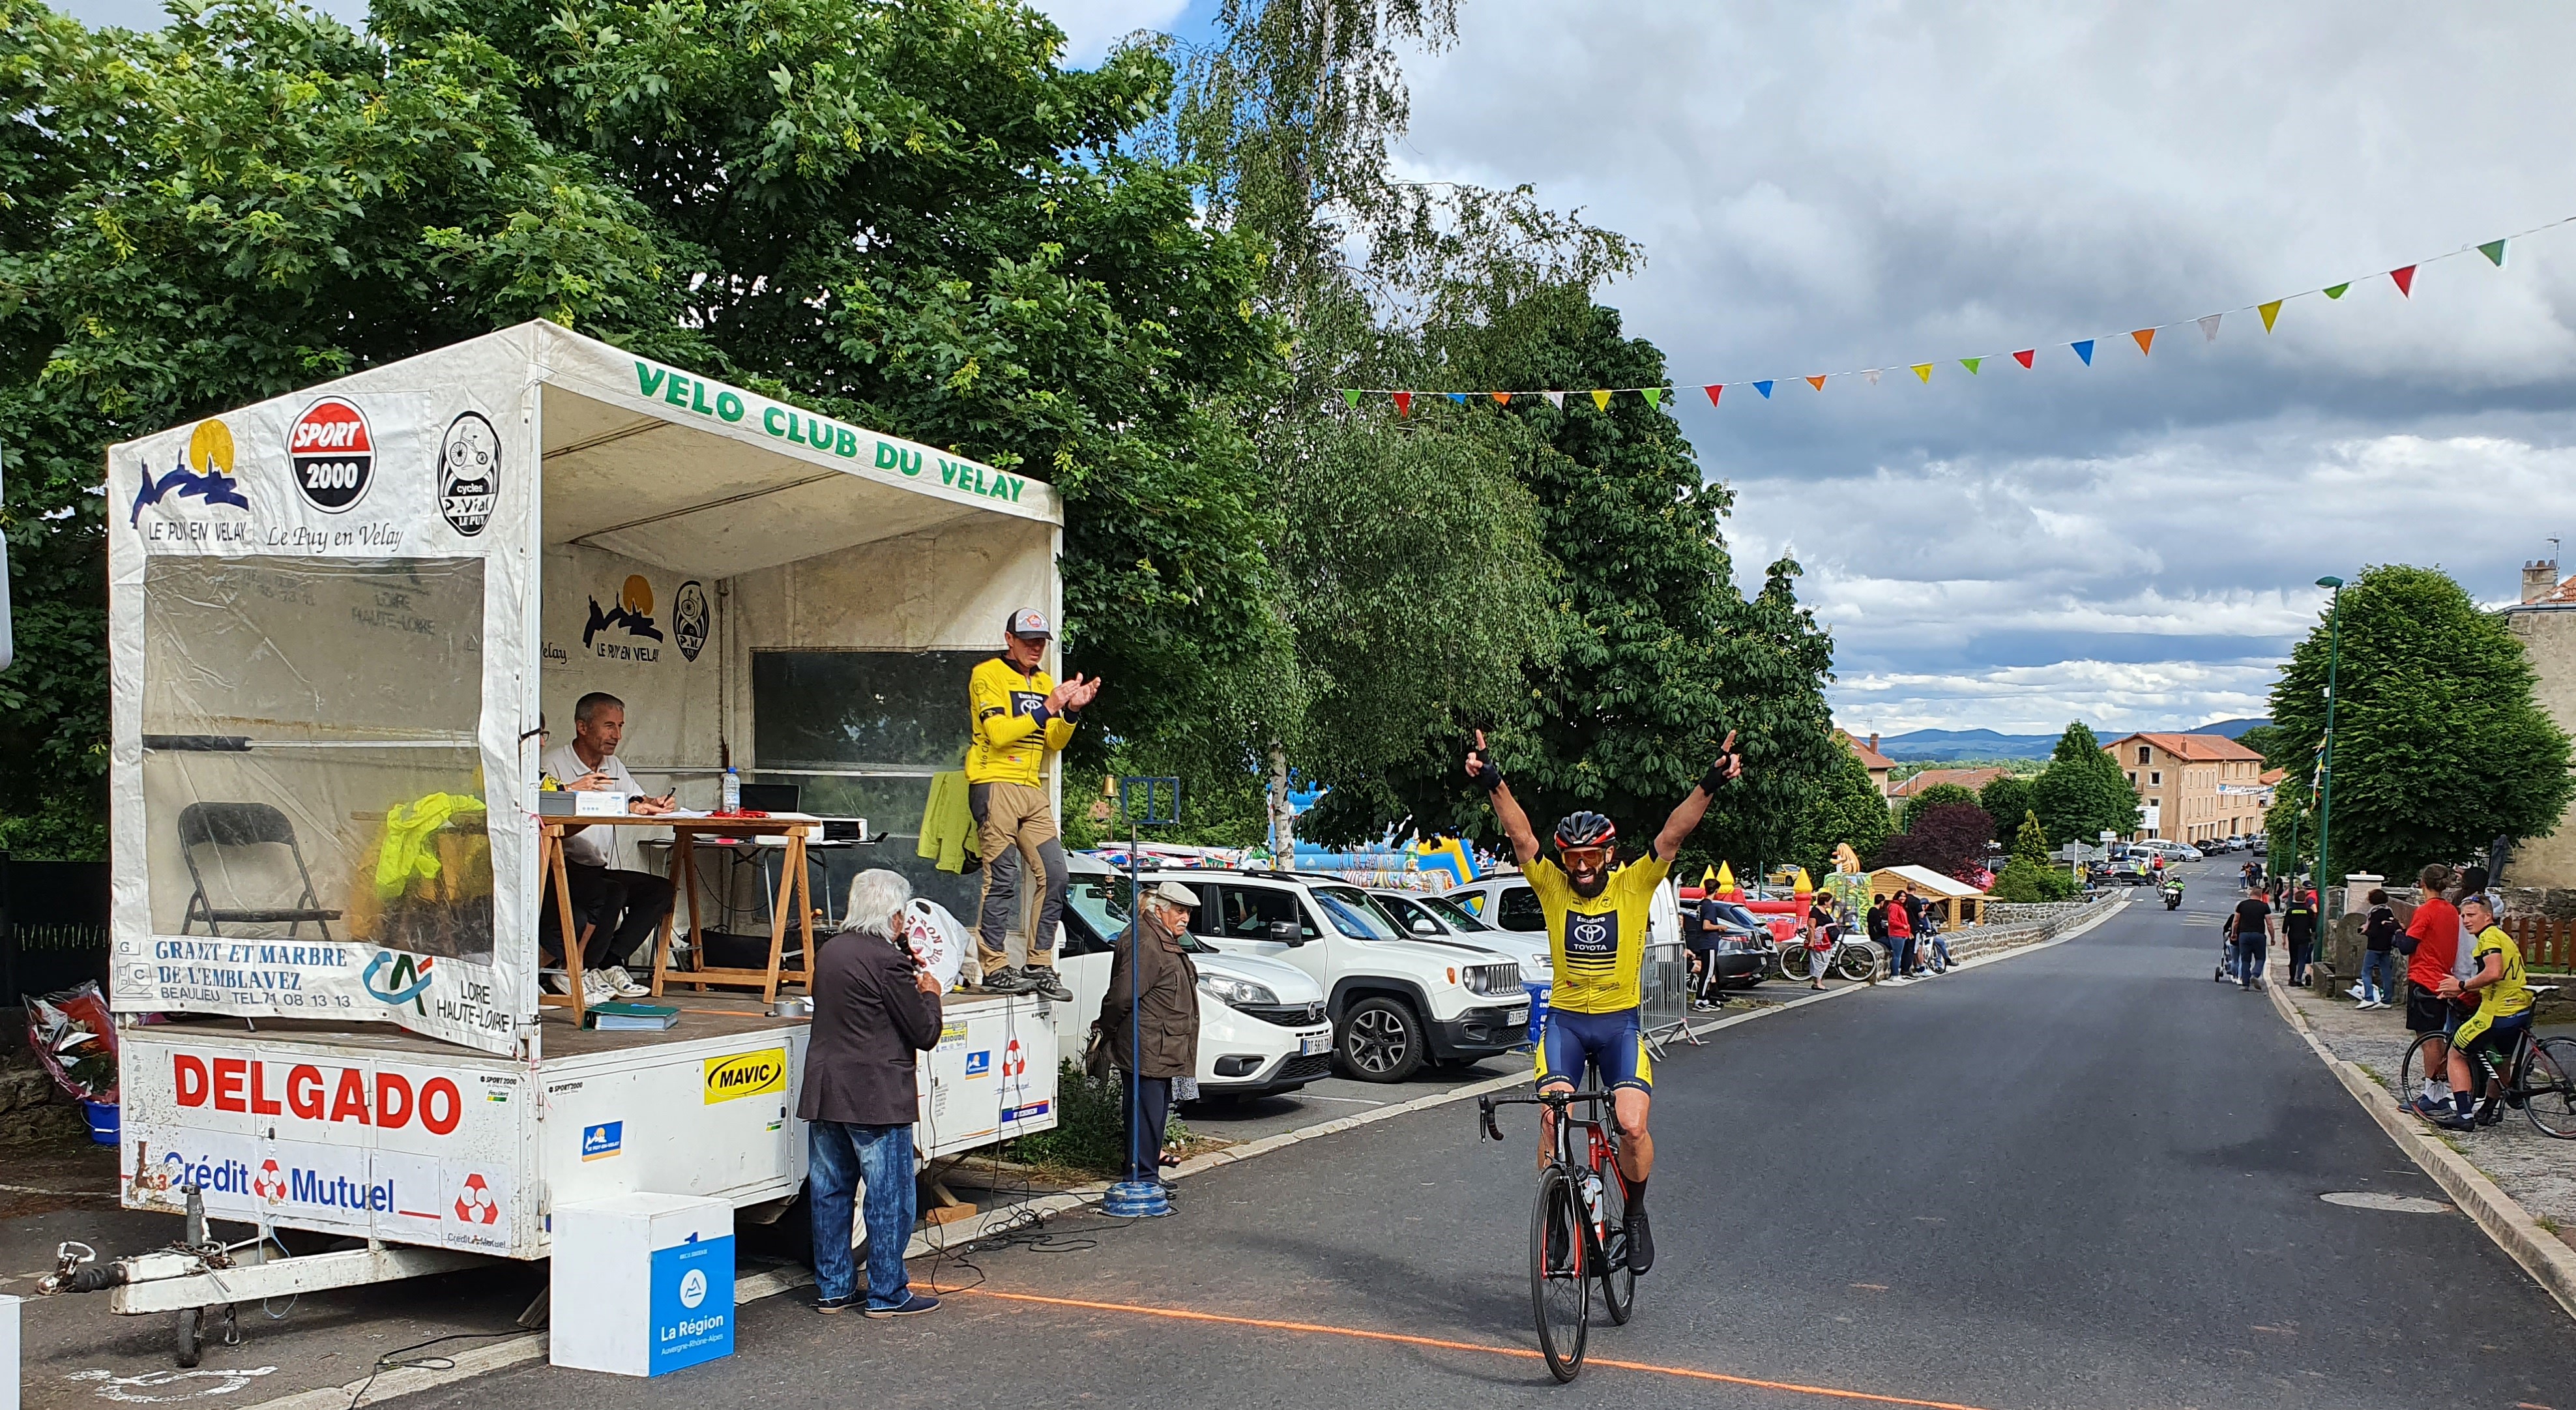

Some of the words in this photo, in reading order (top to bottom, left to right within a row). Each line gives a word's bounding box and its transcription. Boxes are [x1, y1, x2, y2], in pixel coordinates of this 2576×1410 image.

[294, 422, 361, 447] SPORT
[634, 360, 745, 423] VELO
[763, 405, 858, 459] CLUB
[874, 440, 923, 477] DU
[937, 458, 1026, 503] VELAY
[306, 462, 359, 489] 2000
[456, 483, 483, 495] cycles
[149, 522, 162, 540] LE
[168, 522, 187, 540] PUY
[190, 522, 209, 540] EN
[215, 521, 247, 541] VELAY
[459, 516, 469, 526] LE
[469, 516, 485, 525] PUY
[267, 527, 289, 546] Le
[293, 527, 329, 553] Puy
[334, 531, 355, 546] en
[359, 523, 404, 552] Velay
[542, 641, 568, 664] elay
[597, 643, 606, 657] LE
[621, 646, 630, 660] EN
[229, 944, 254, 963] ET
[258, 945, 347, 967] MARBRE
[157, 965, 181, 984] DE
[188, 967, 302, 991] L'EMBLAVEZ
[161, 987, 220, 1002] BEAULIEU
[284, 994, 304, 1006] 08
[311, 995, 327, 1007] 13
[335, 995, 351, 1008] 13
[460, 980, 490, 1005] LOIRE
[437, 999, 510, 1033] HAUTE-LOIRE
[941, 1033, 965, 1043] BRIOUDE
[554, 1083, 570, 1092] SPORT
[719, 1064, 770, 1089] MAVIC
[173, 1053, 461, 1135] DELGADO
[164, 1152, 248, 1195] Crédit
[292, 1167, 394, 1213] Mutuel
[447, 1233, 471, 1244] Crédit
[660, 1327, 676, 1342] La
[679, 1314, 724, 1337] Région
[661, 1333, 724, 1356] Auvergne-Rhône-Alpes
